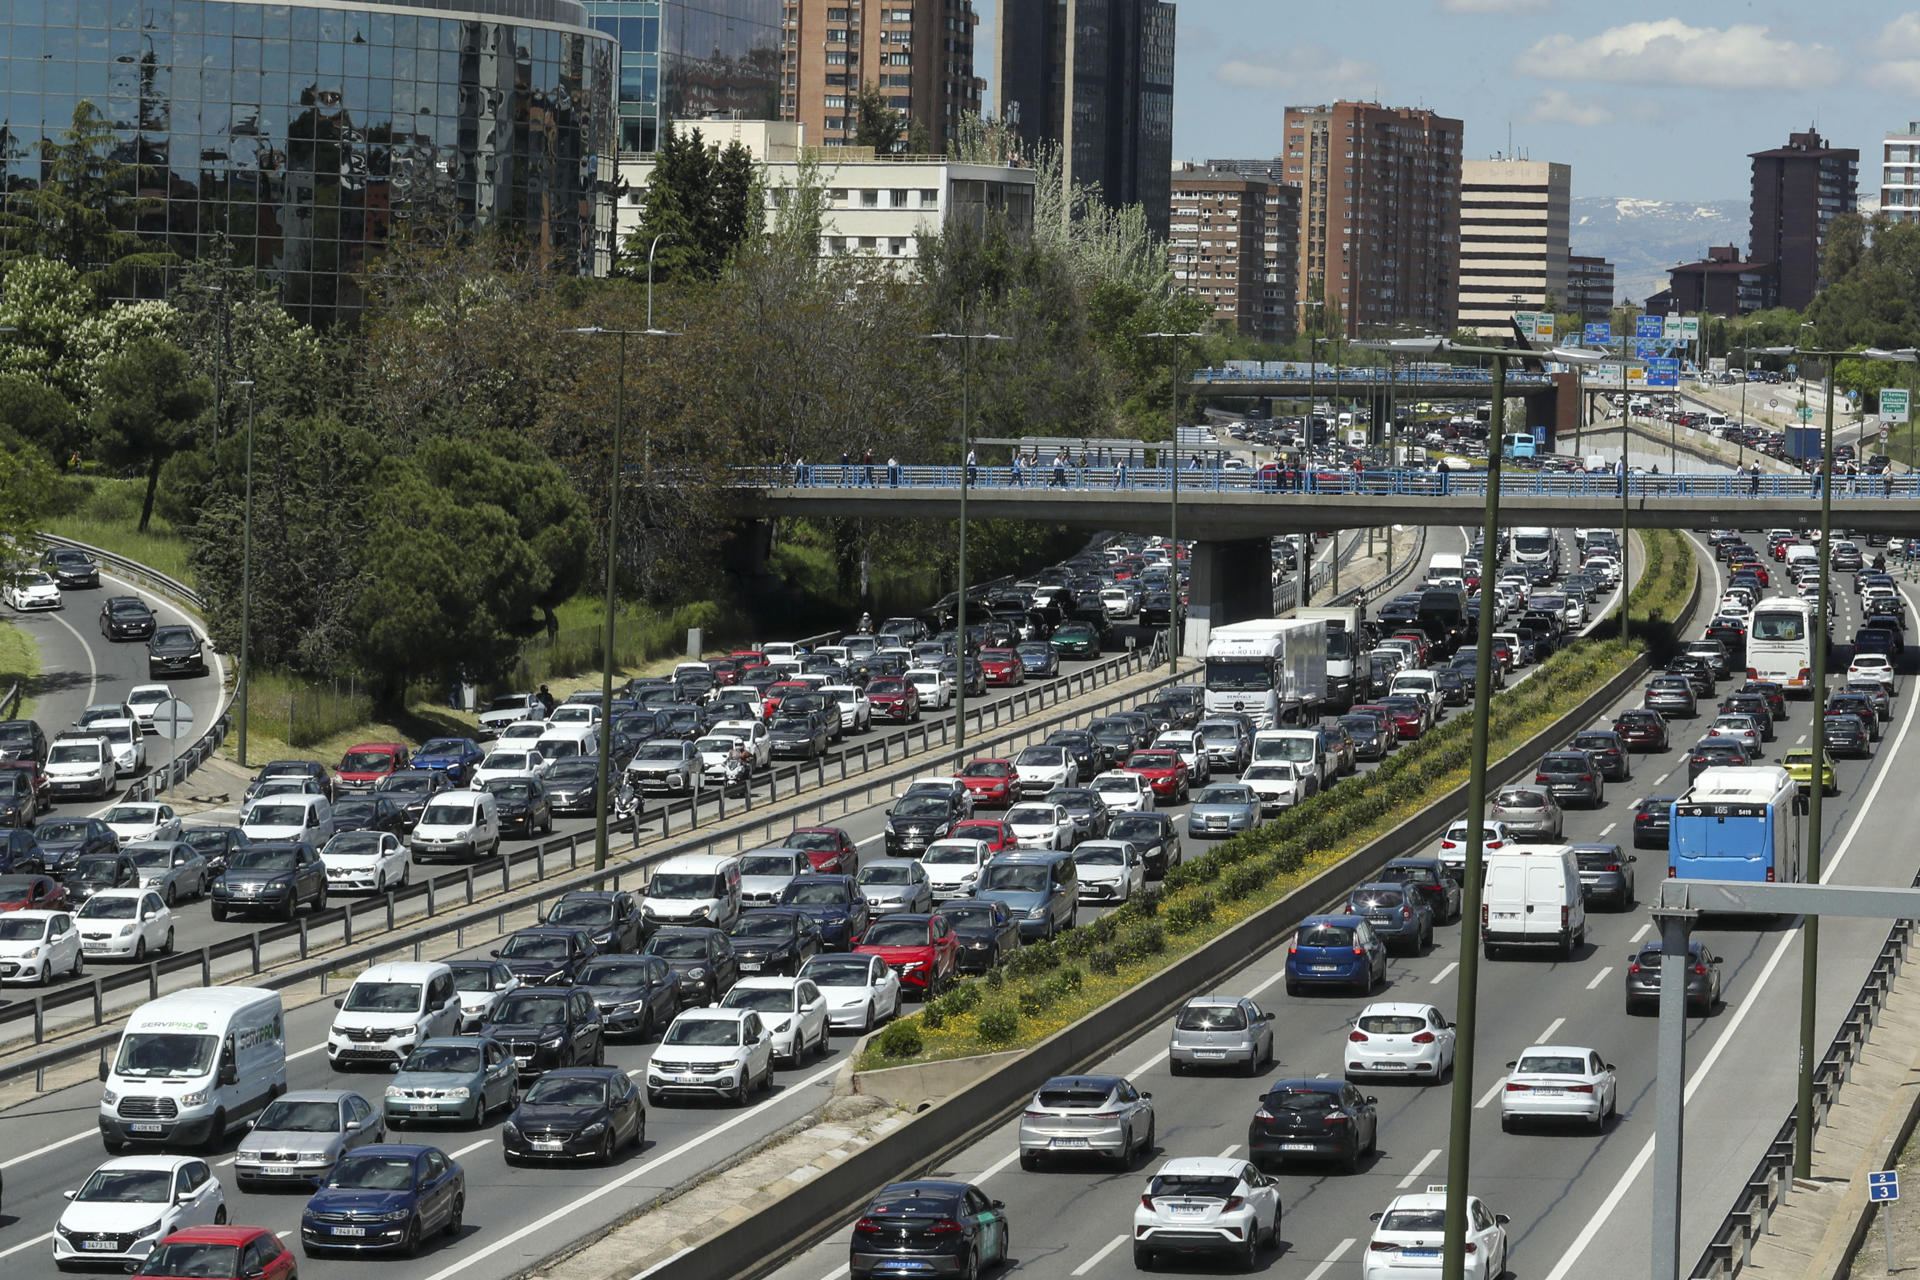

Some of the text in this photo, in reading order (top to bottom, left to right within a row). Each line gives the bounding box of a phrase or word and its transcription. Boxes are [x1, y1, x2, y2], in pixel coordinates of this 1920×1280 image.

[1714, 806, 1728, 814] 165
[1879, 1174, 1887, 1183] 2
[1880, 1186, 1889, 1198] 3
